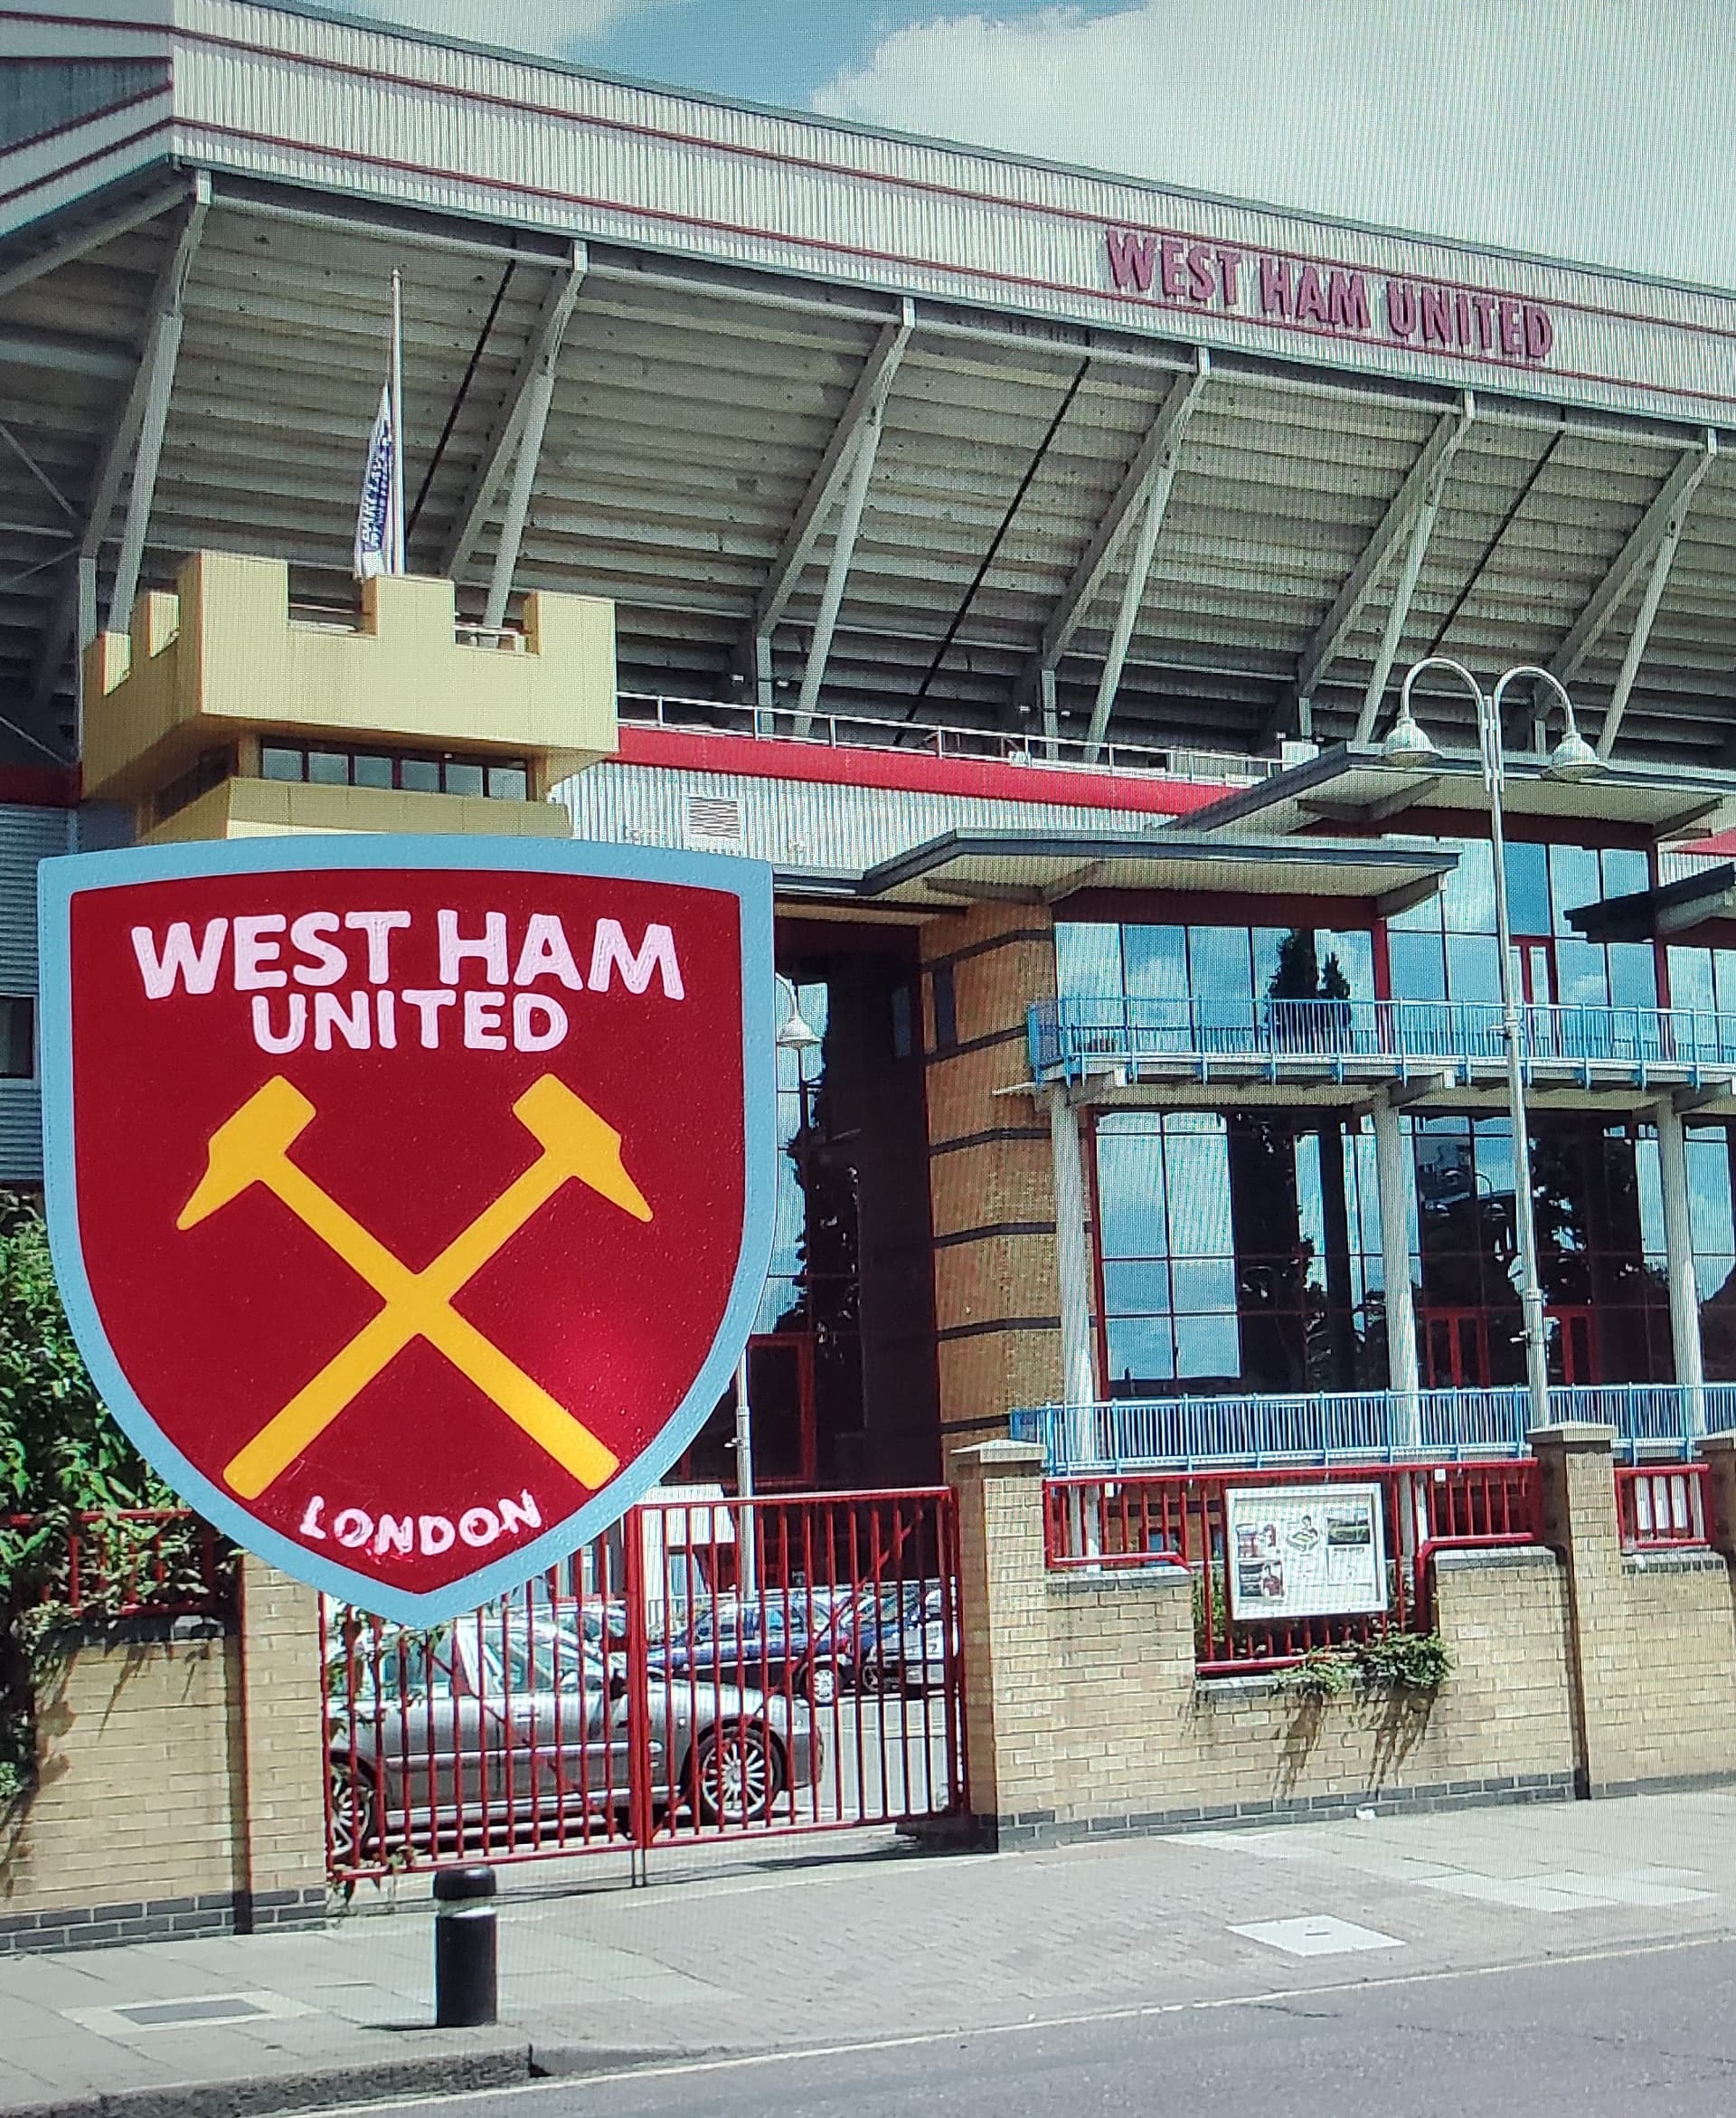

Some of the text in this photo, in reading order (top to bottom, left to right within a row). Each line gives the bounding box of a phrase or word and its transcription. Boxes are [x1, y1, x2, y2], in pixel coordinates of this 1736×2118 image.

[1105, 230, 1553, 359] WEST HAM UNITED
[131, 909, 685, 1000] WEST HAM
[252, 989, 570, 1054] UNITED
[299, 1489, 542, 1556] LONDON
